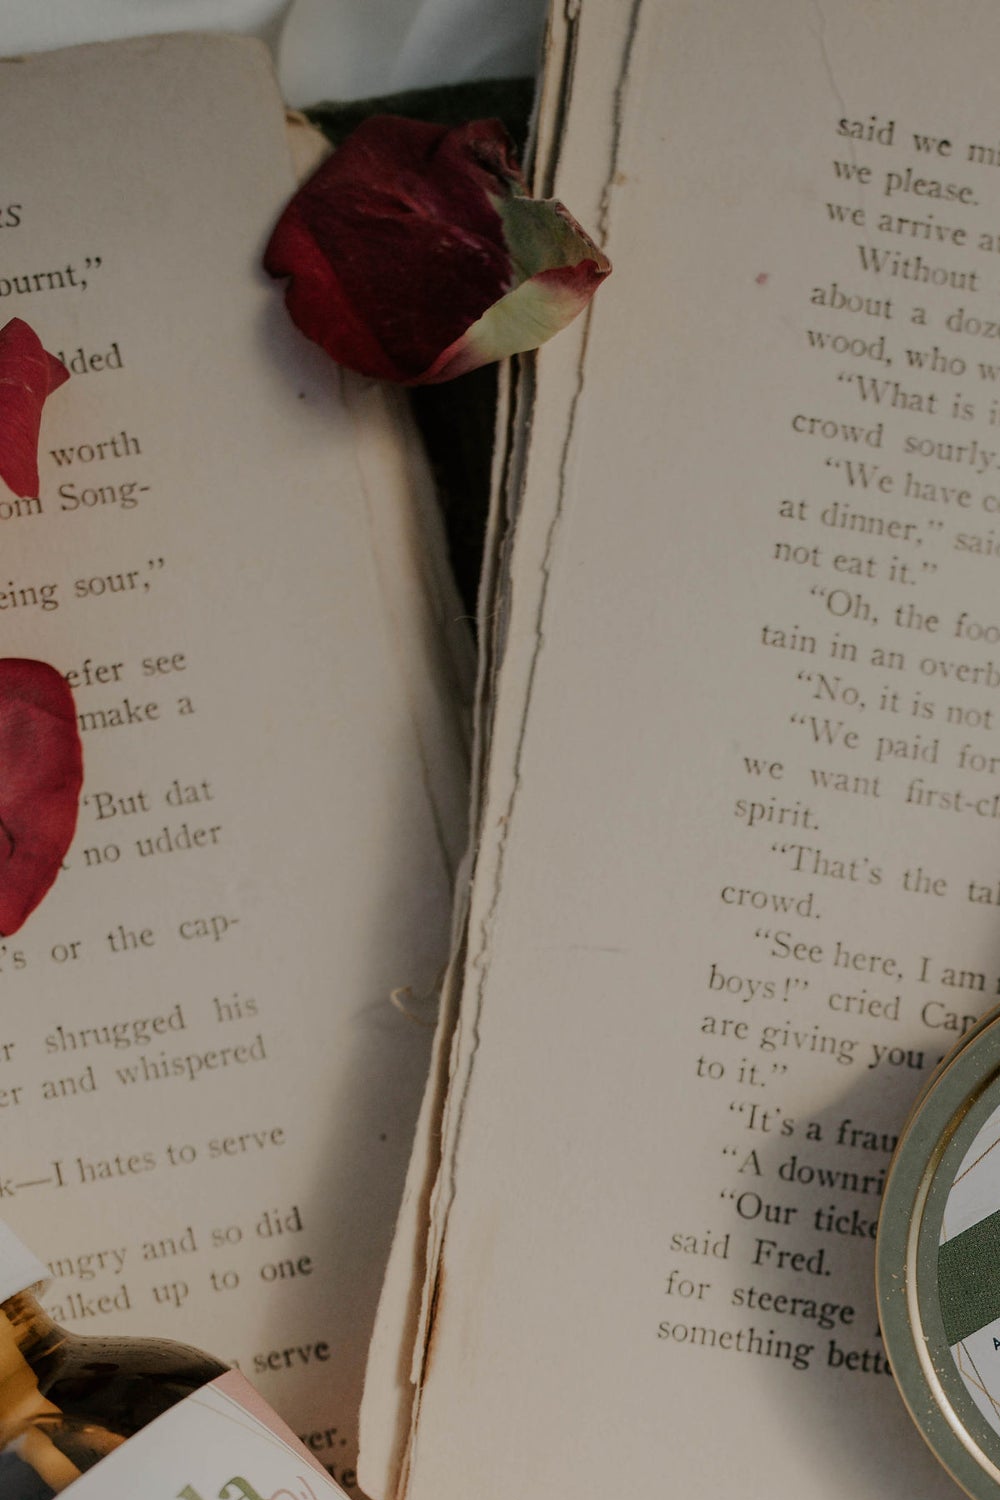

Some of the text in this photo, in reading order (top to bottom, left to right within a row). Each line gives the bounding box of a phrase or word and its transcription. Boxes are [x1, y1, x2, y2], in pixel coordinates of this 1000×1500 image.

[836, 115, 896, 146] said
[912, 134, 952, 157] we
[833, 160, 872, 184] we
[884, 167, 979, 206] please.
[50, 433, 143, 467] worth
[57, 481, 151, 512] Song-
[73, 557, 165, 599] sour,”
[141, 652, 187, 677] see
[79, 696, 196, 731] make a
[164, 778, 215, 807] dat
[743, 756, 784, 781] we
[810, 769, 880, 798] want
[734, 798, 820, 831] spirit.
[82, 822, 222, 867] no udder
[902, 866, 948, 897] the
[720, 886, 821, 920] crowd.
[51, 915, 240, 963] or the cap-
[755, 929, 986, 992] “See here, I am
[45, 992, 258, 1054] shrugged his
[828, 990, 901, 1022] cried
[41, 1033, 267, 1100] and whispered
[76, 1128, 285, 1184] hates to serve
[142, 1205, 305, 1261] and so did
[670, 1234, 832, 1277] said Fred.
[151, 1255, 314, 1309] up to one
[665, 1270, 856, 1330] for steerage
[253, 1342, 331, 1374] serve
[657, 1322, 815, 1371] something
